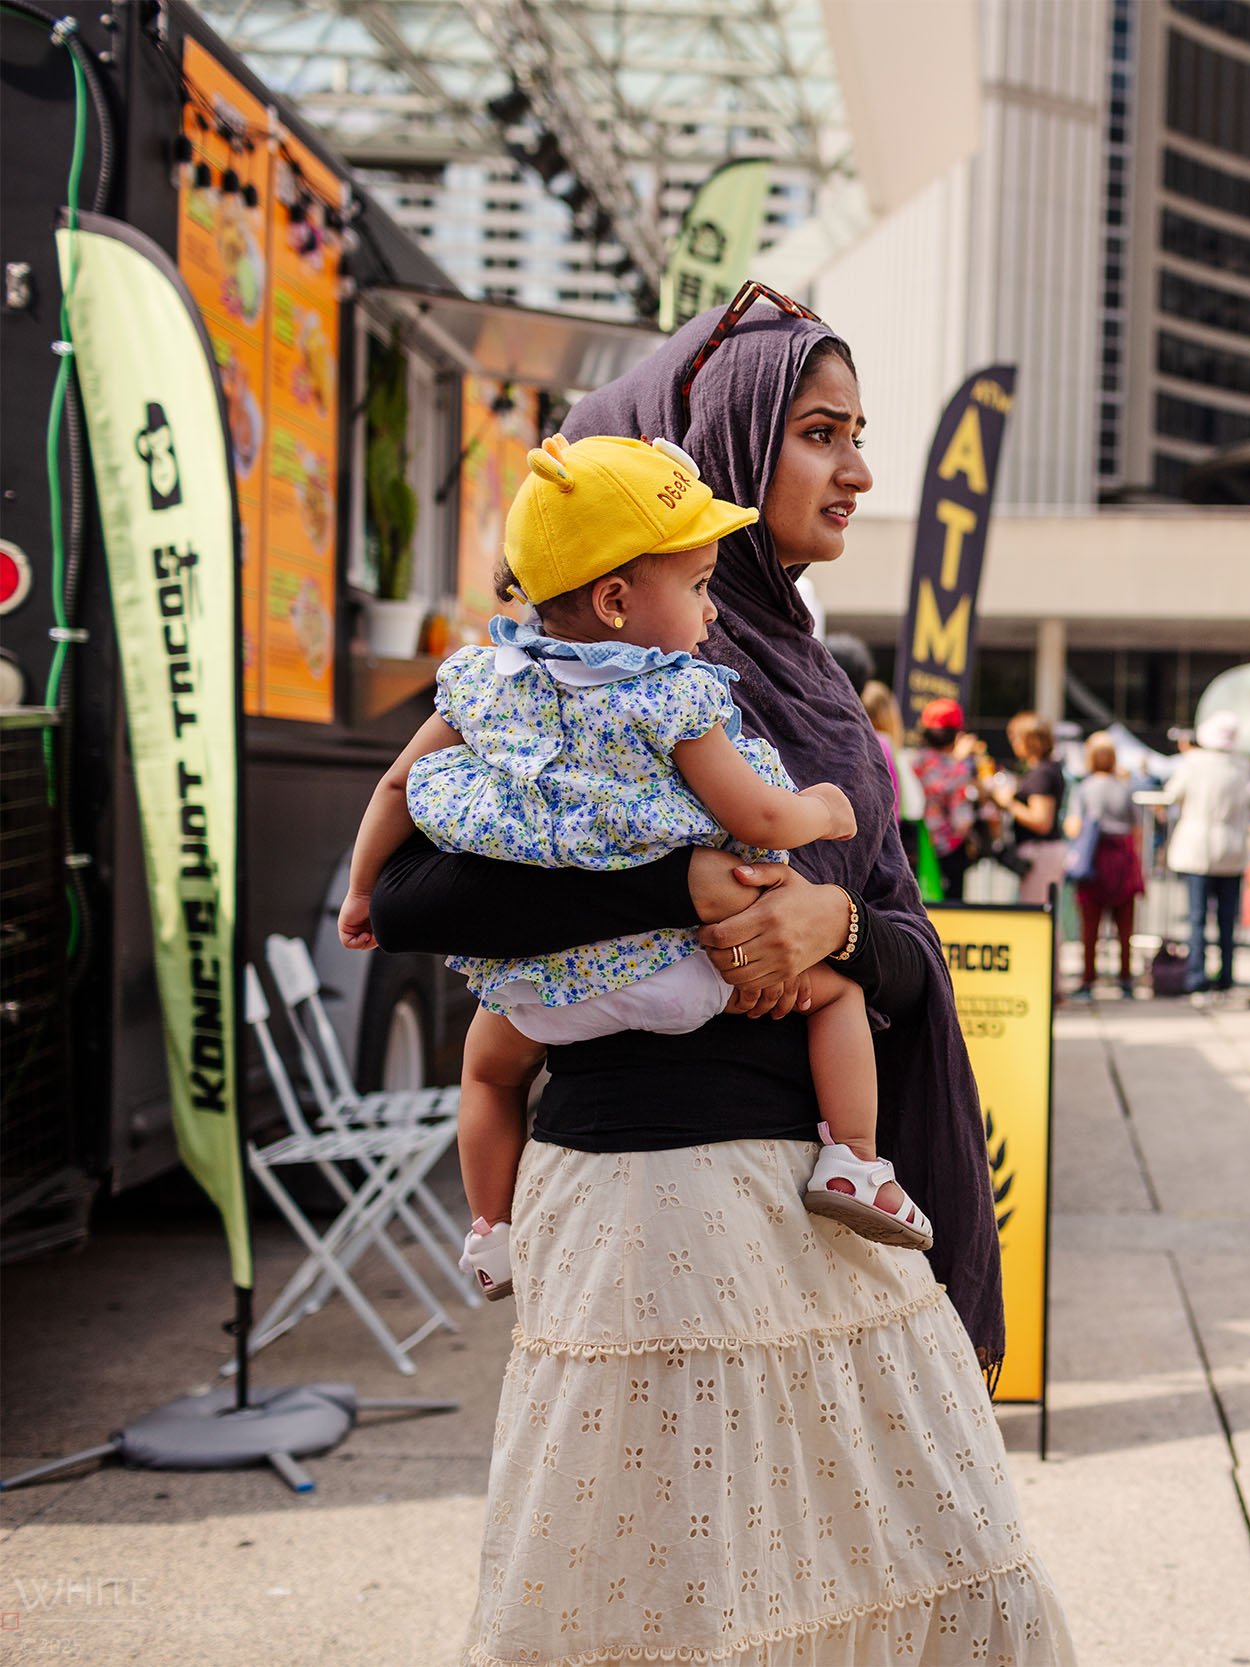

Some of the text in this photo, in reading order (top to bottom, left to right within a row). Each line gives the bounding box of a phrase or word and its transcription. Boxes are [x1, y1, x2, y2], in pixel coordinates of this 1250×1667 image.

[911, 402, 988, 675] ATM
[153, 545, 199, 739] TACOS
[177, 760, 215, 878] HOT
[942, 944, 1009, 971] ACOS
